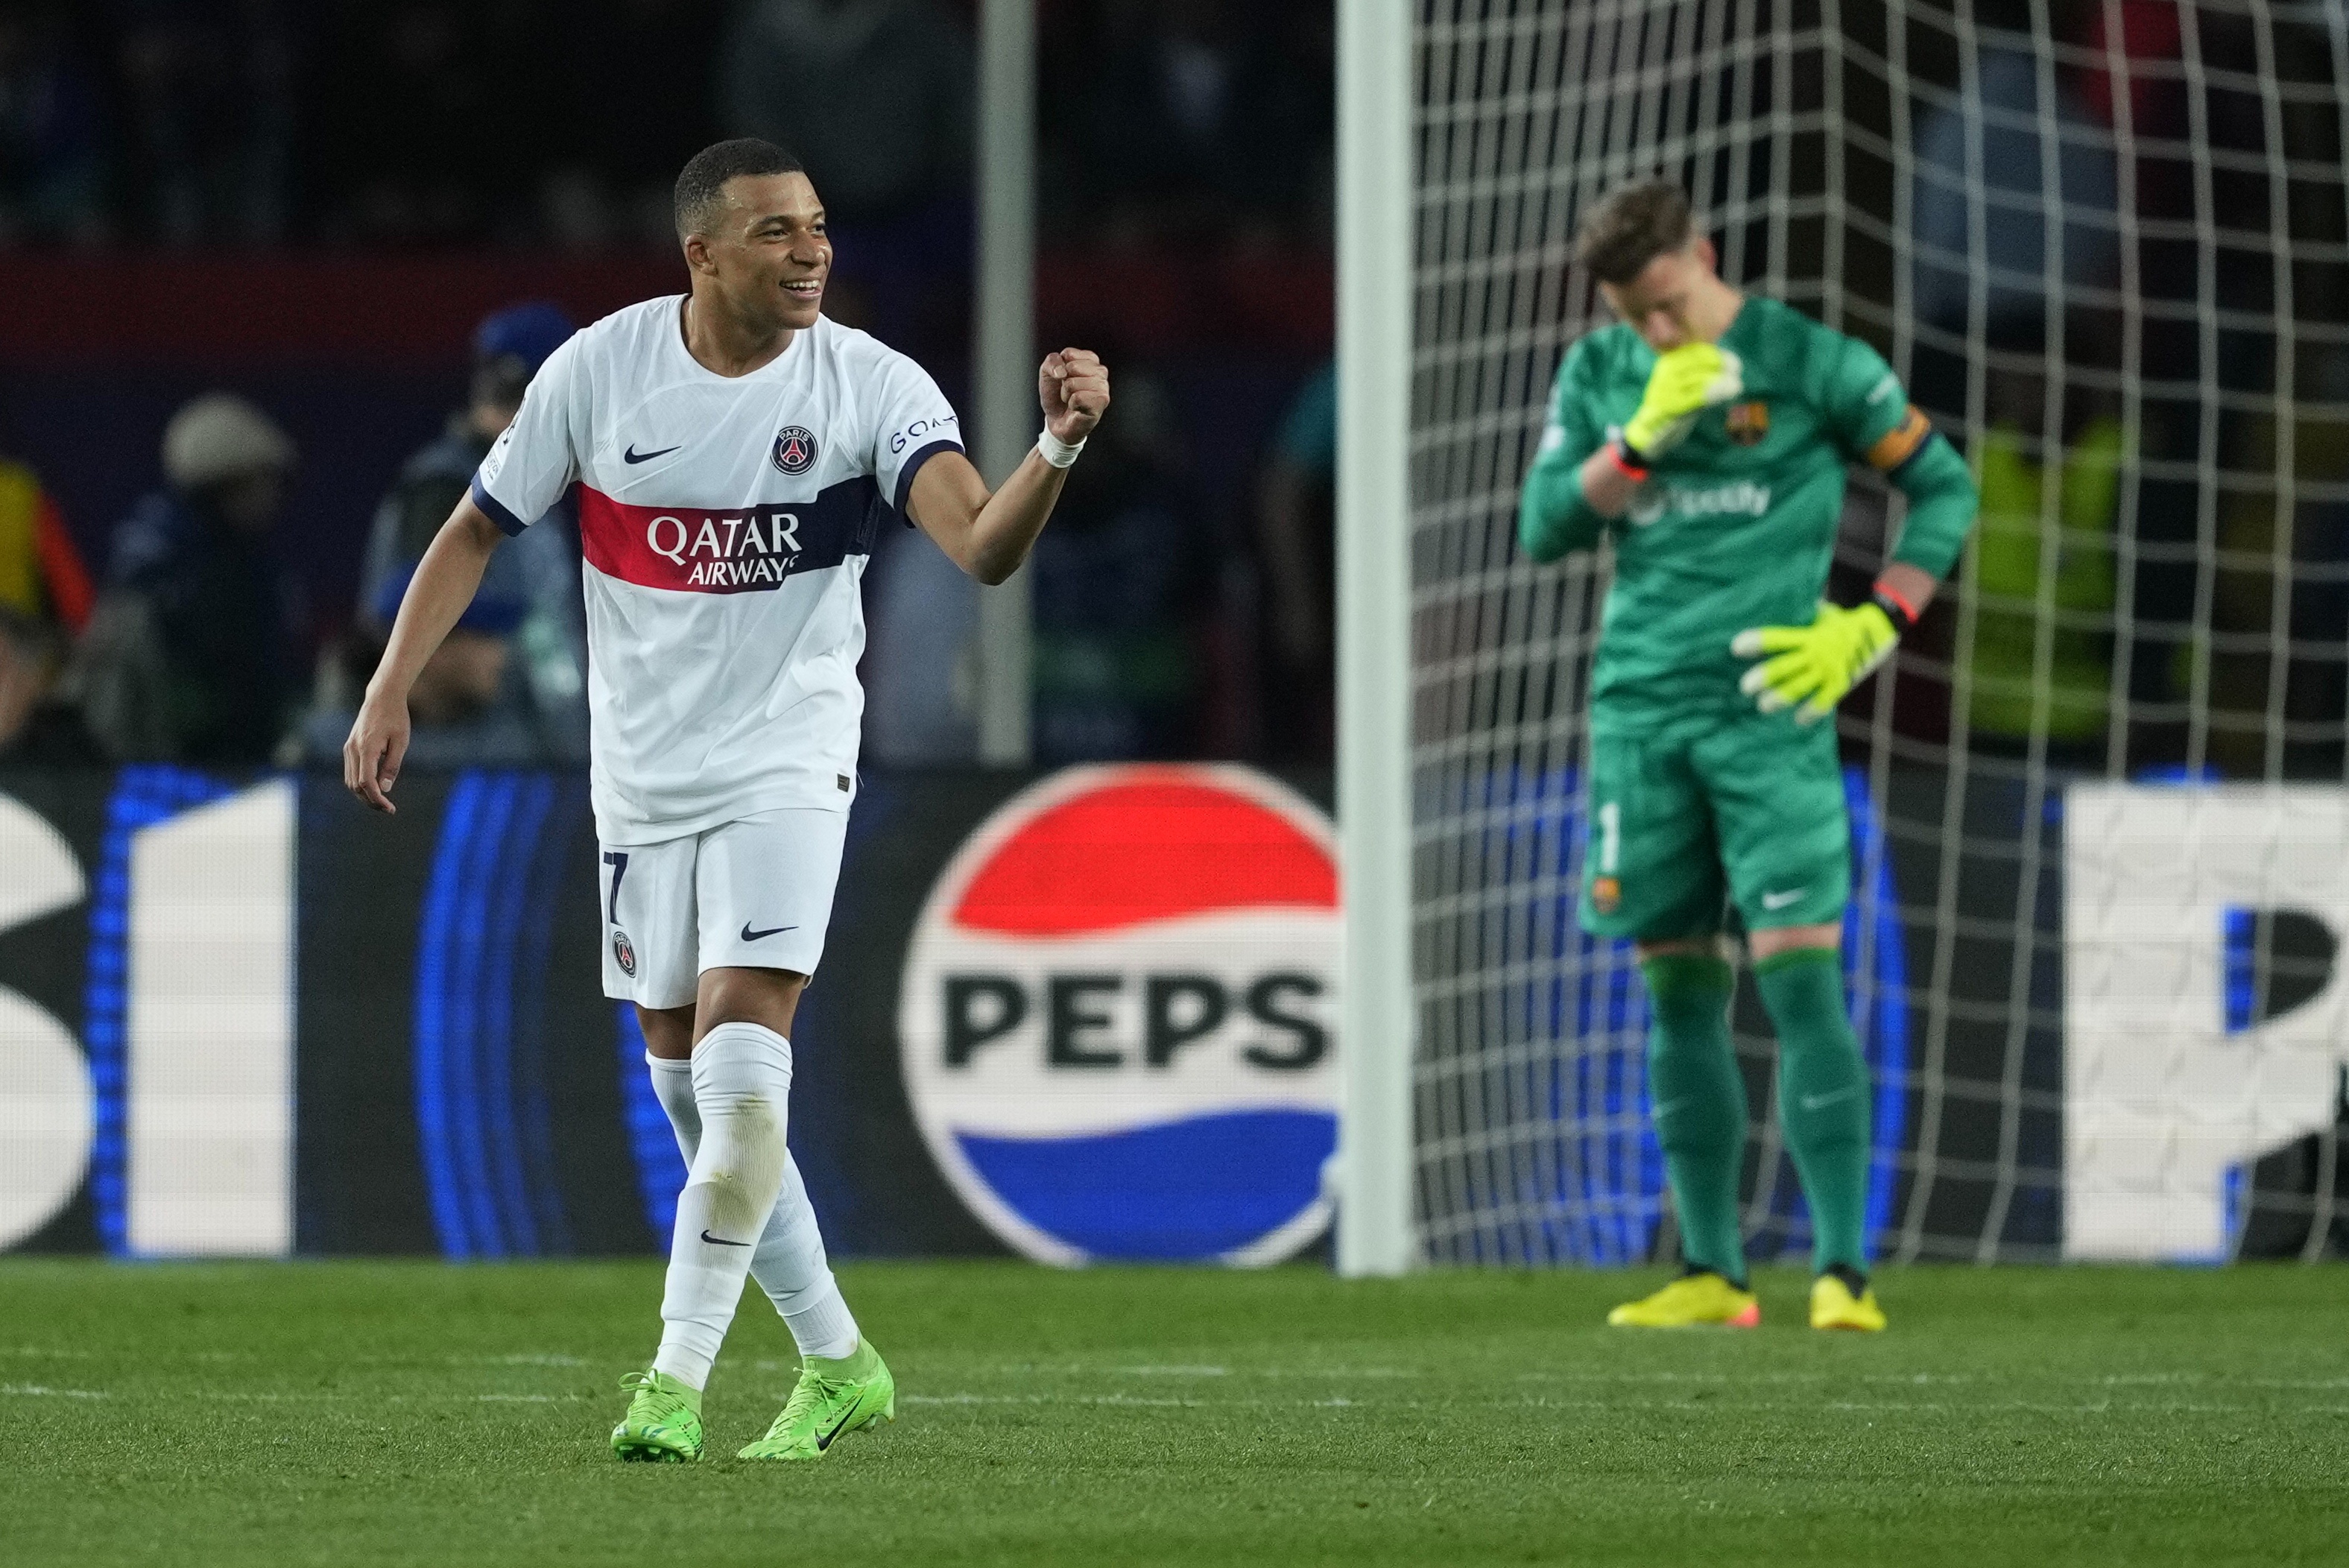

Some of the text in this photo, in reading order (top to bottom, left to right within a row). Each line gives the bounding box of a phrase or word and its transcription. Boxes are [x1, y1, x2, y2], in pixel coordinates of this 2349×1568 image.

[779, 429, 810, 443] PARIS
[647, 513, 803, 566] QATAR
[1599, 800, 1621, 873] 1
[604, 851, 629, 927] 7
[943, 973, 1330, 1071] PEPS
